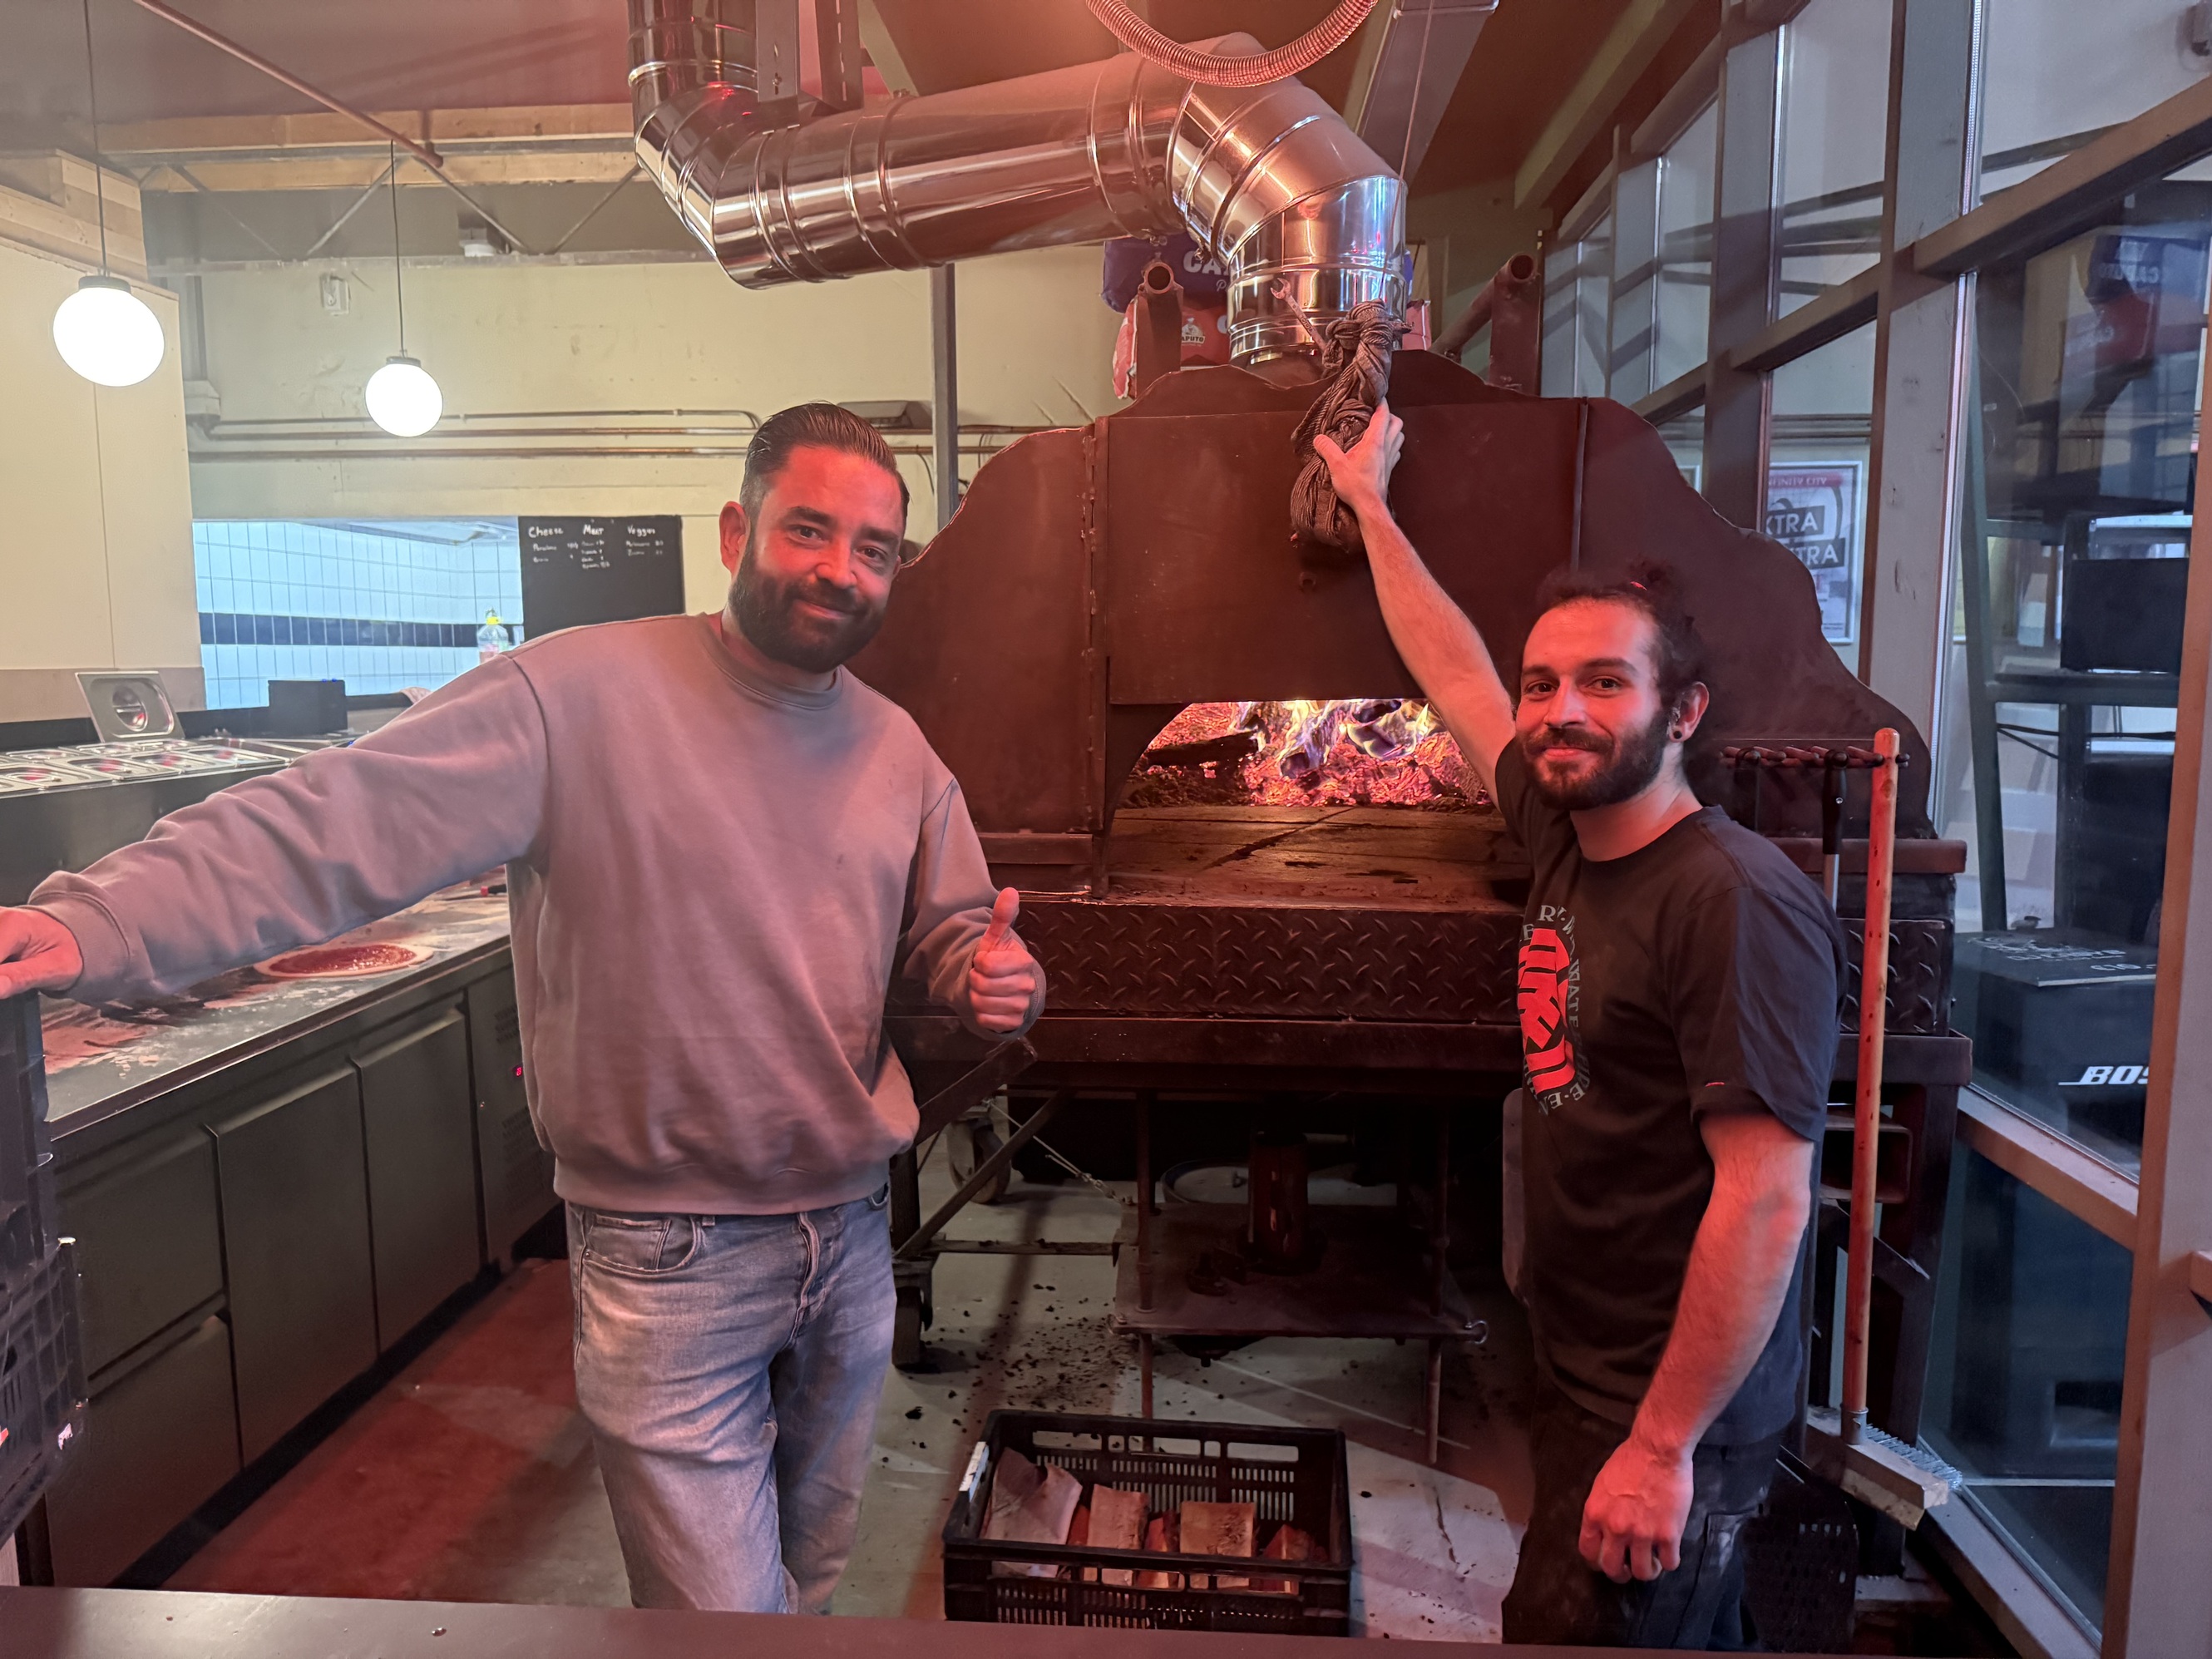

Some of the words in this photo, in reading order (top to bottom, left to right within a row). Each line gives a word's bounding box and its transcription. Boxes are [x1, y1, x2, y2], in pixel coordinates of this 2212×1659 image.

[1183, 250, 1229, 276] CA
[1766, 511, 1819, 535] XTRA
[1791, 544, 1839, 565] TRA
